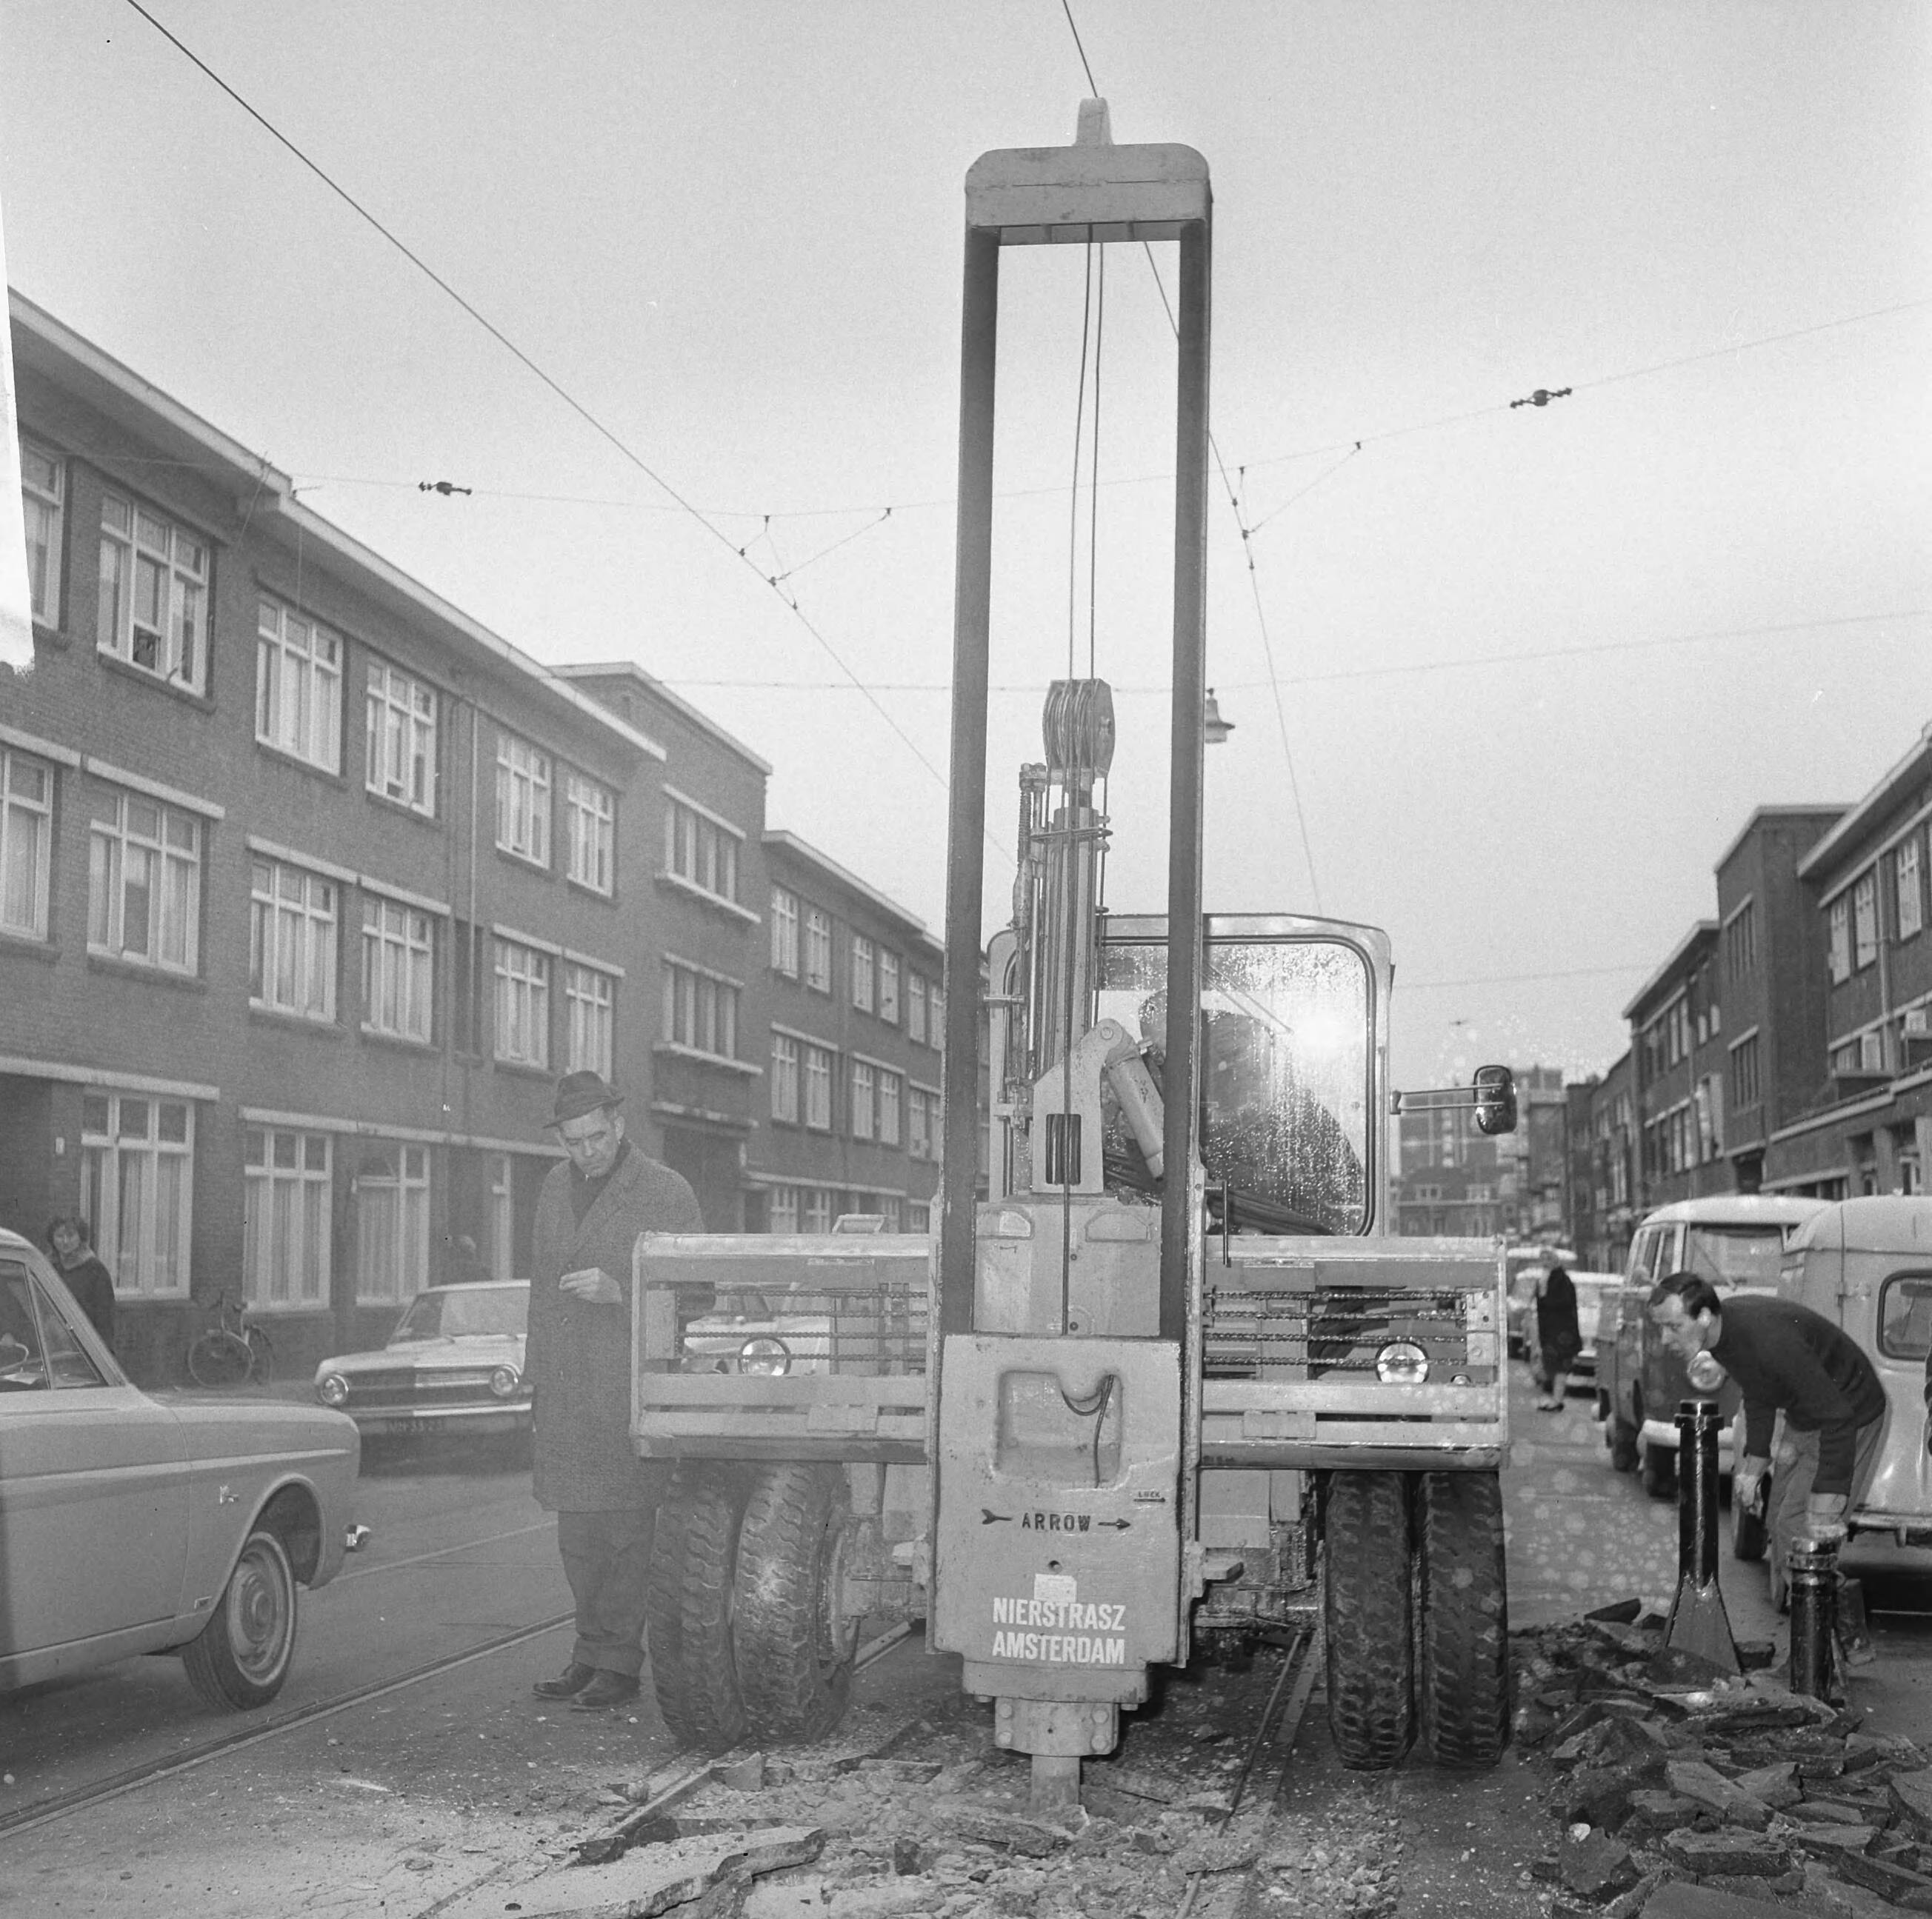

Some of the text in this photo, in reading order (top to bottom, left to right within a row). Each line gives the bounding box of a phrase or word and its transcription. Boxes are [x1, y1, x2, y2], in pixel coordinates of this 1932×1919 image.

[1022, 1512, 1091, 1532] ARROW
[993, 1597, 1126, 1631] NIERSTRASZ
[992, 1630, 1125, 1665] AMSTERDAM
